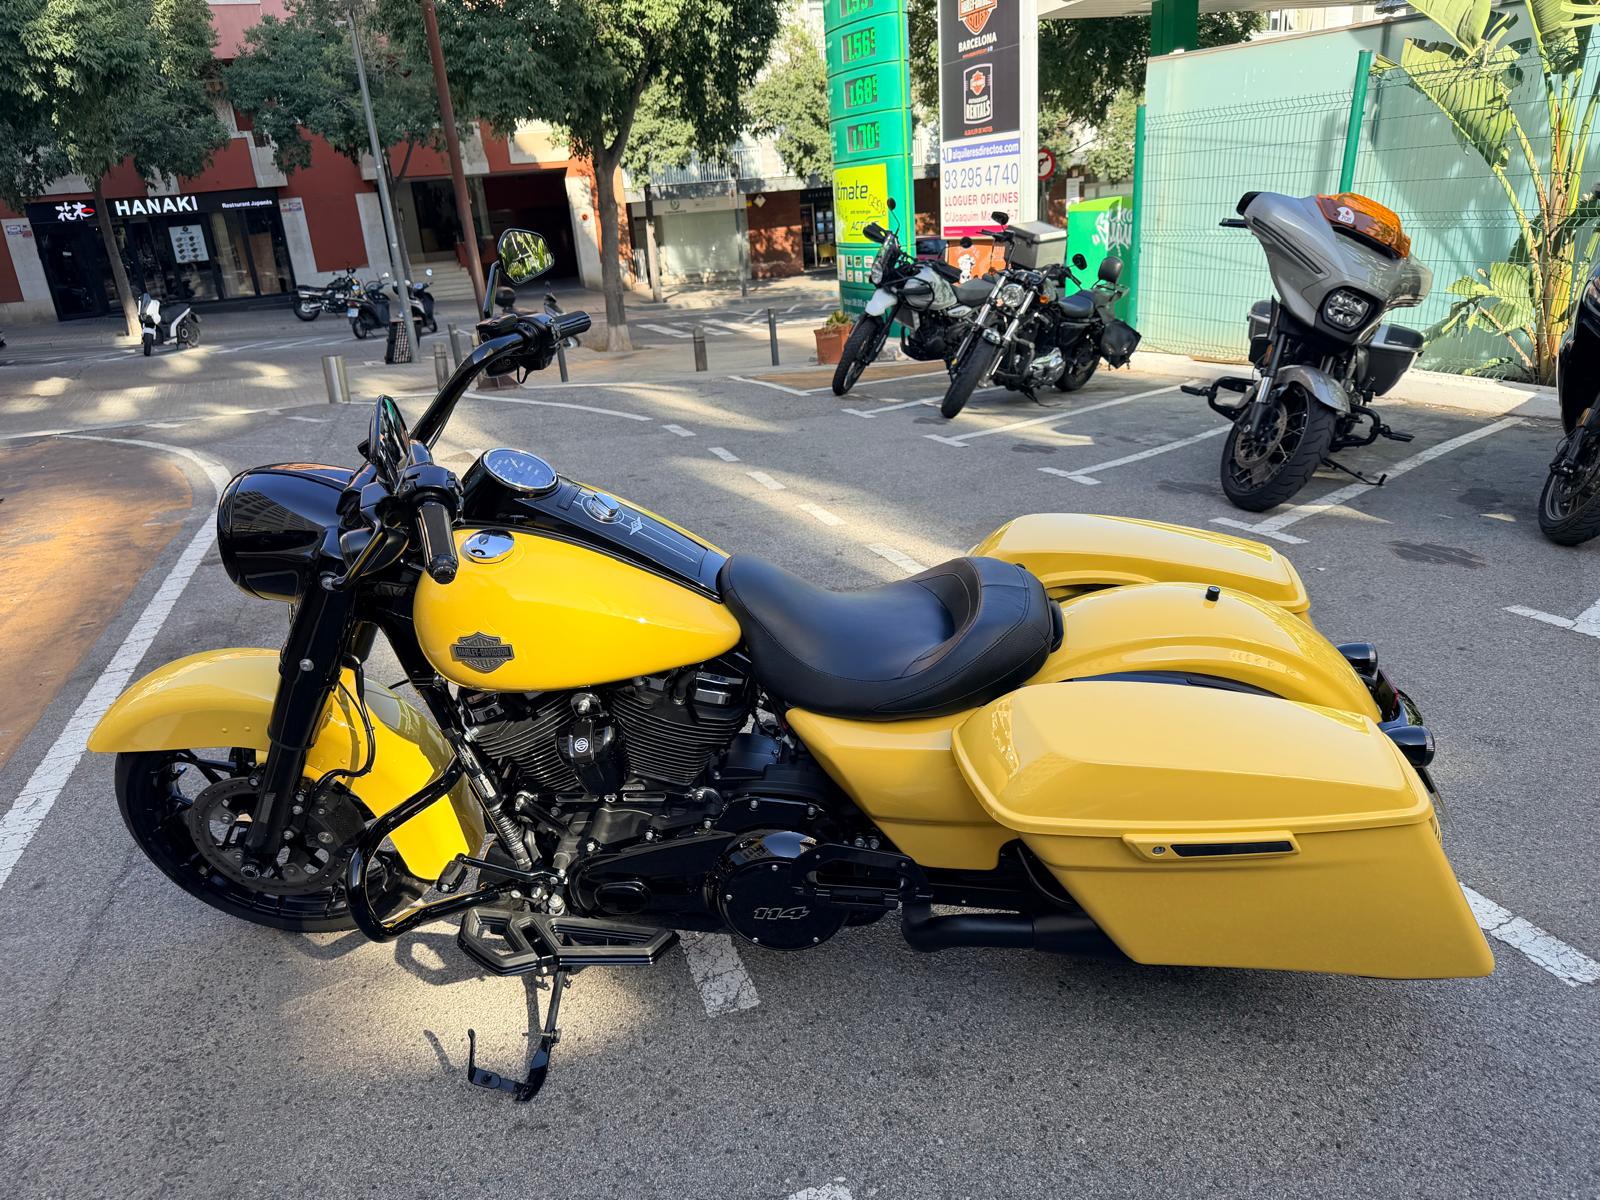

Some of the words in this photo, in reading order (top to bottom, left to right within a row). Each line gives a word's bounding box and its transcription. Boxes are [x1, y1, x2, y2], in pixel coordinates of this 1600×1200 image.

[958, 32, 997, 53] BARCELONA
[944, 170, 958, 190] 93
[960, 167, 982, 188] 295
[115, 195, 198, 216] HANAKI
[944, 194, 978, 207] LLOGUER
[981, 191, 1019, 205] OFICINES
[456, 646, 510, 657] HARLEY-DAVIDSON
[753, 906, 810, 920] 114
